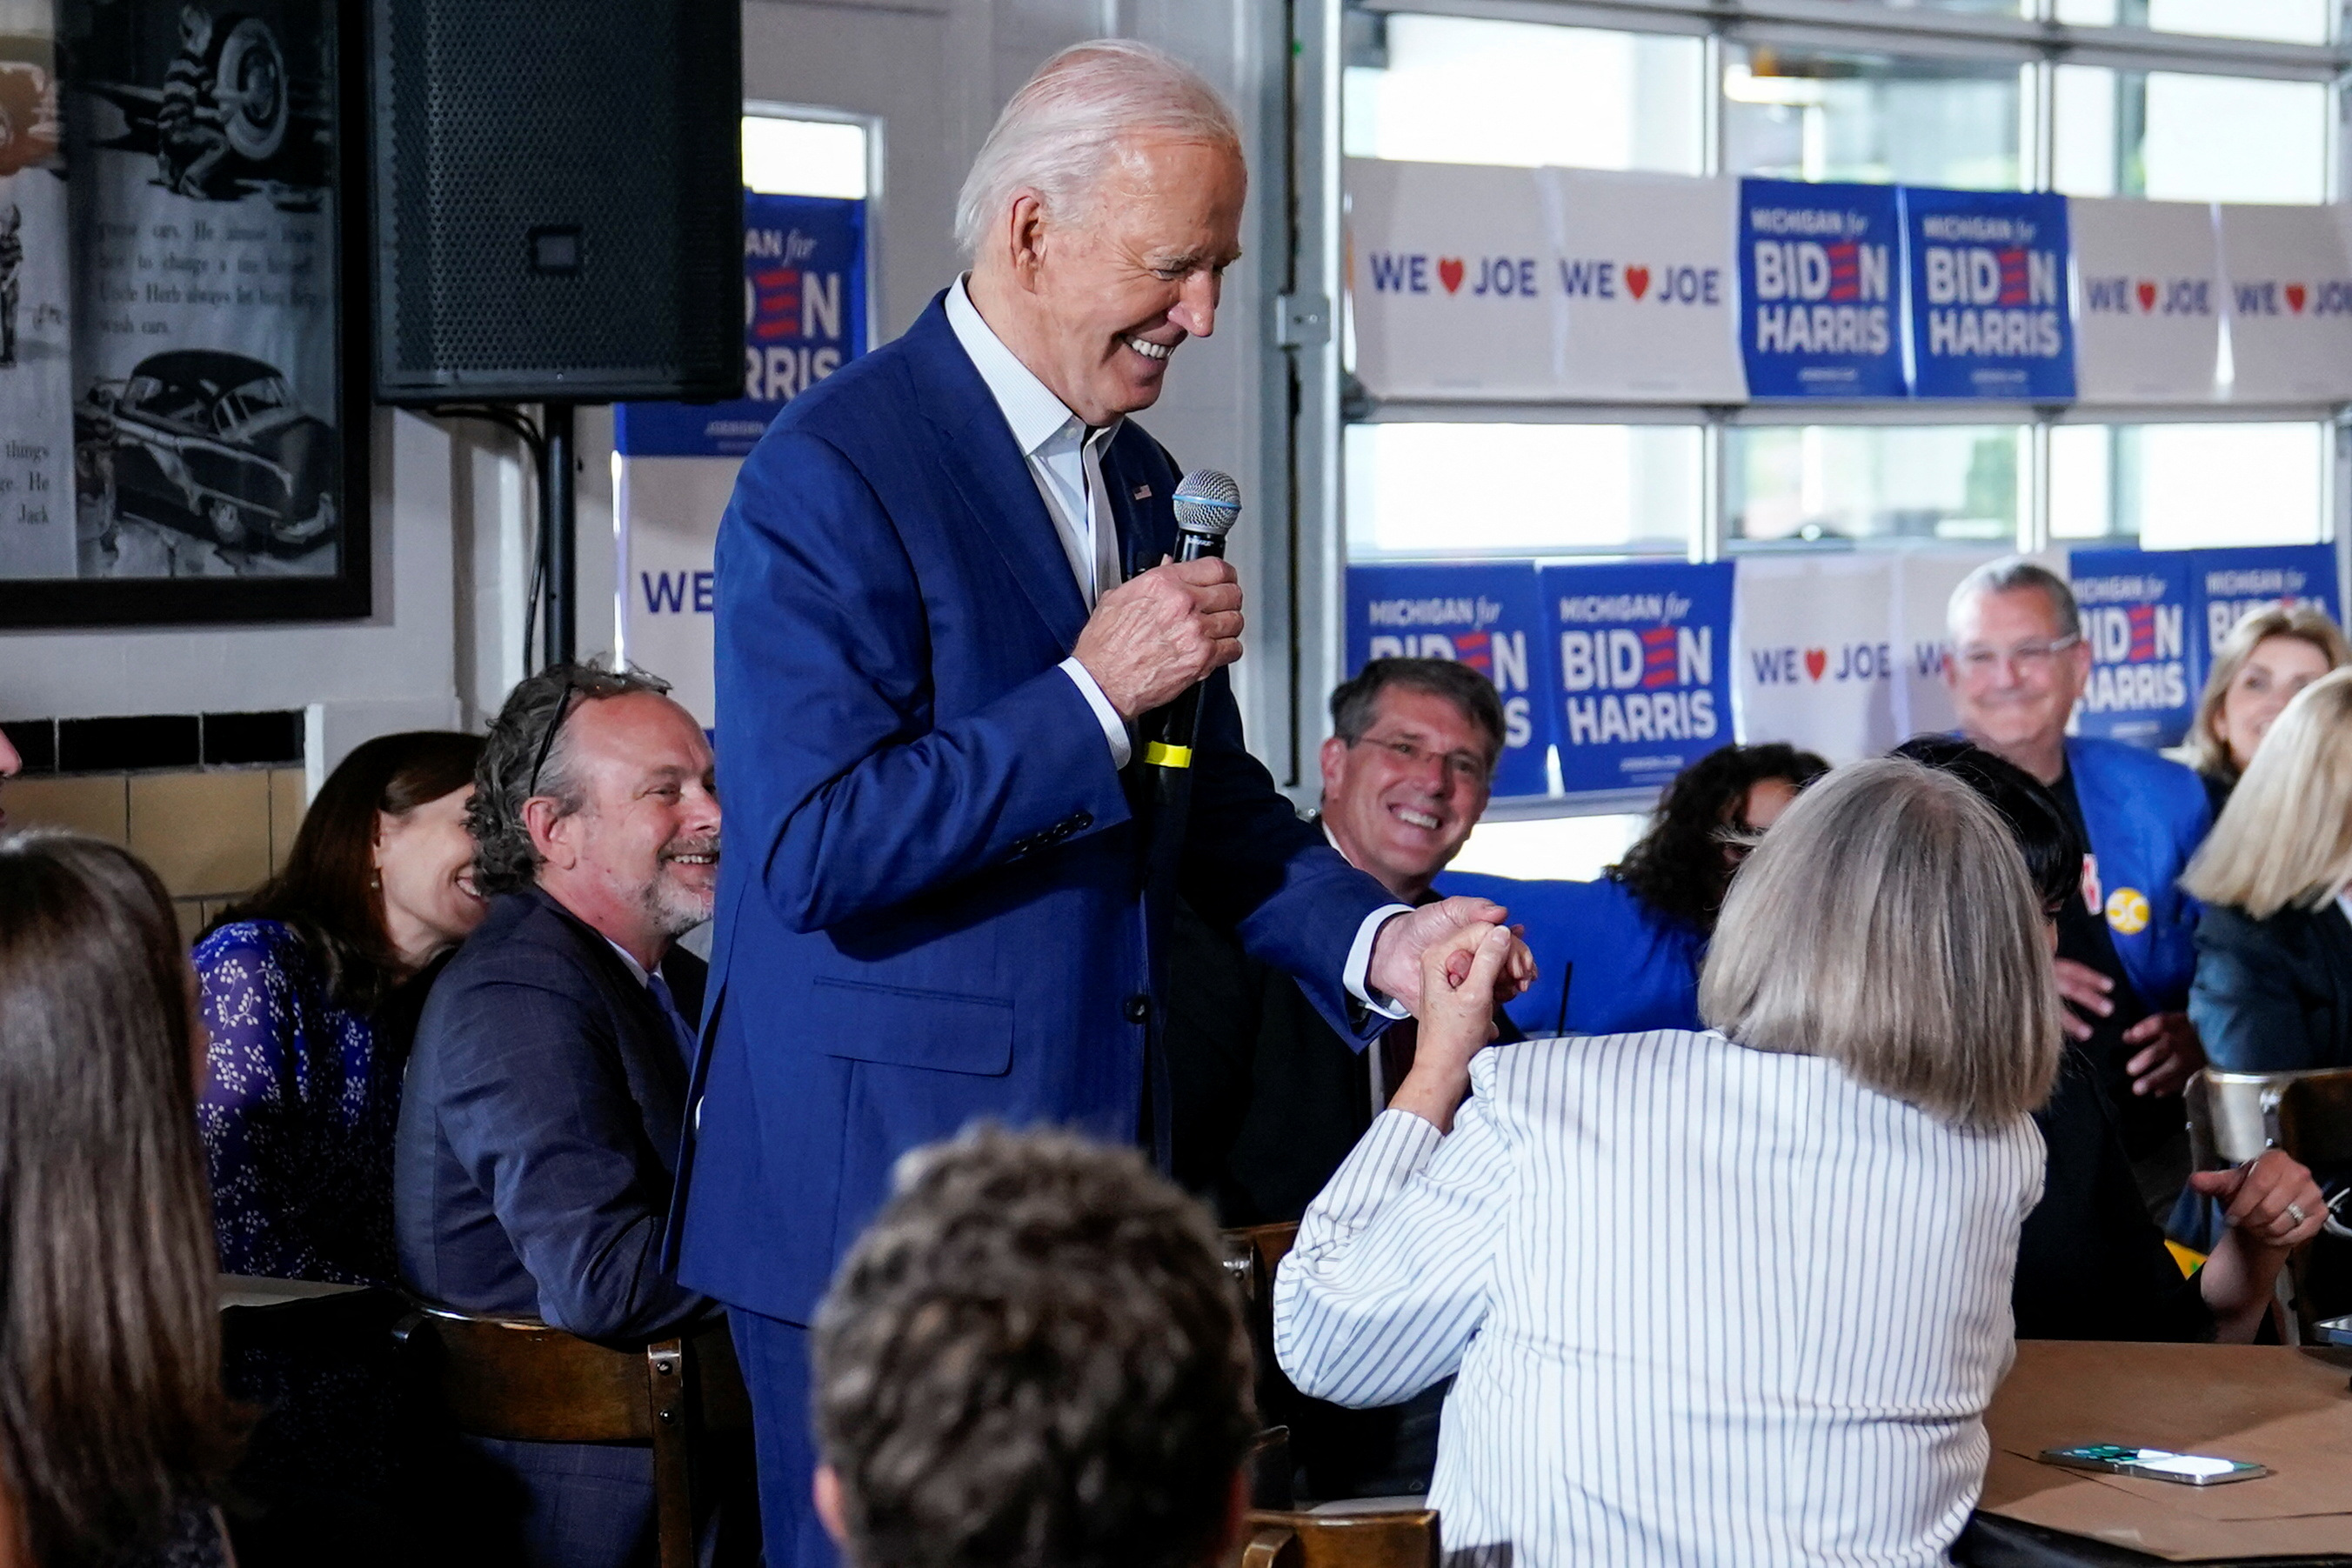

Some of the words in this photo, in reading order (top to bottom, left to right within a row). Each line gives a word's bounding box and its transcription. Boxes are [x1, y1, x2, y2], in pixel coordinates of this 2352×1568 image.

[1750, 207, 1842, 236] MICHIGAN
[1922, 215, 2012, 242] MICHIGAN
[782, 227, 818, 267] for
[1369, 253, 1429, 293] WE
[1473, 257, 1537, 297] JOE
[1560, 258, 1615, 300] WE
[1659, 264, 1720, 305] JOE
[1754, 239, 1889, 301] BIDEN
[1925, 246, 2058, 306] BIDEN
[2086, 276, 2129, 314] WE
[2163, 277, 2210, 315] JOE
[2235, 280, 2279, 316] WE
[1756, 304, 1890, 355] HARRIS
[1928, 308, 2062, 359] HARRIS
[745, 346, 841, 401] RRIS
[29, 470, 50, 491] He
[18, 504, 49, 524] Jack
[642, 570, 713, 614] WE
[1369, 597, 1474, 627] MICHIGAN
[1473, 595, 1503, 631] for
[1560, 593, 1656, 624] MICHIGAN
[1658, 591, 1693, 627] for
[1560, 626, 1713, 691] BIDEN
[1751, 645, 1799, 685] WE
[1834, 640, 1891, 683] JOE
[1915, 641, 1944, 677] W
[1567, 689, 1719, 745] HARRIS
